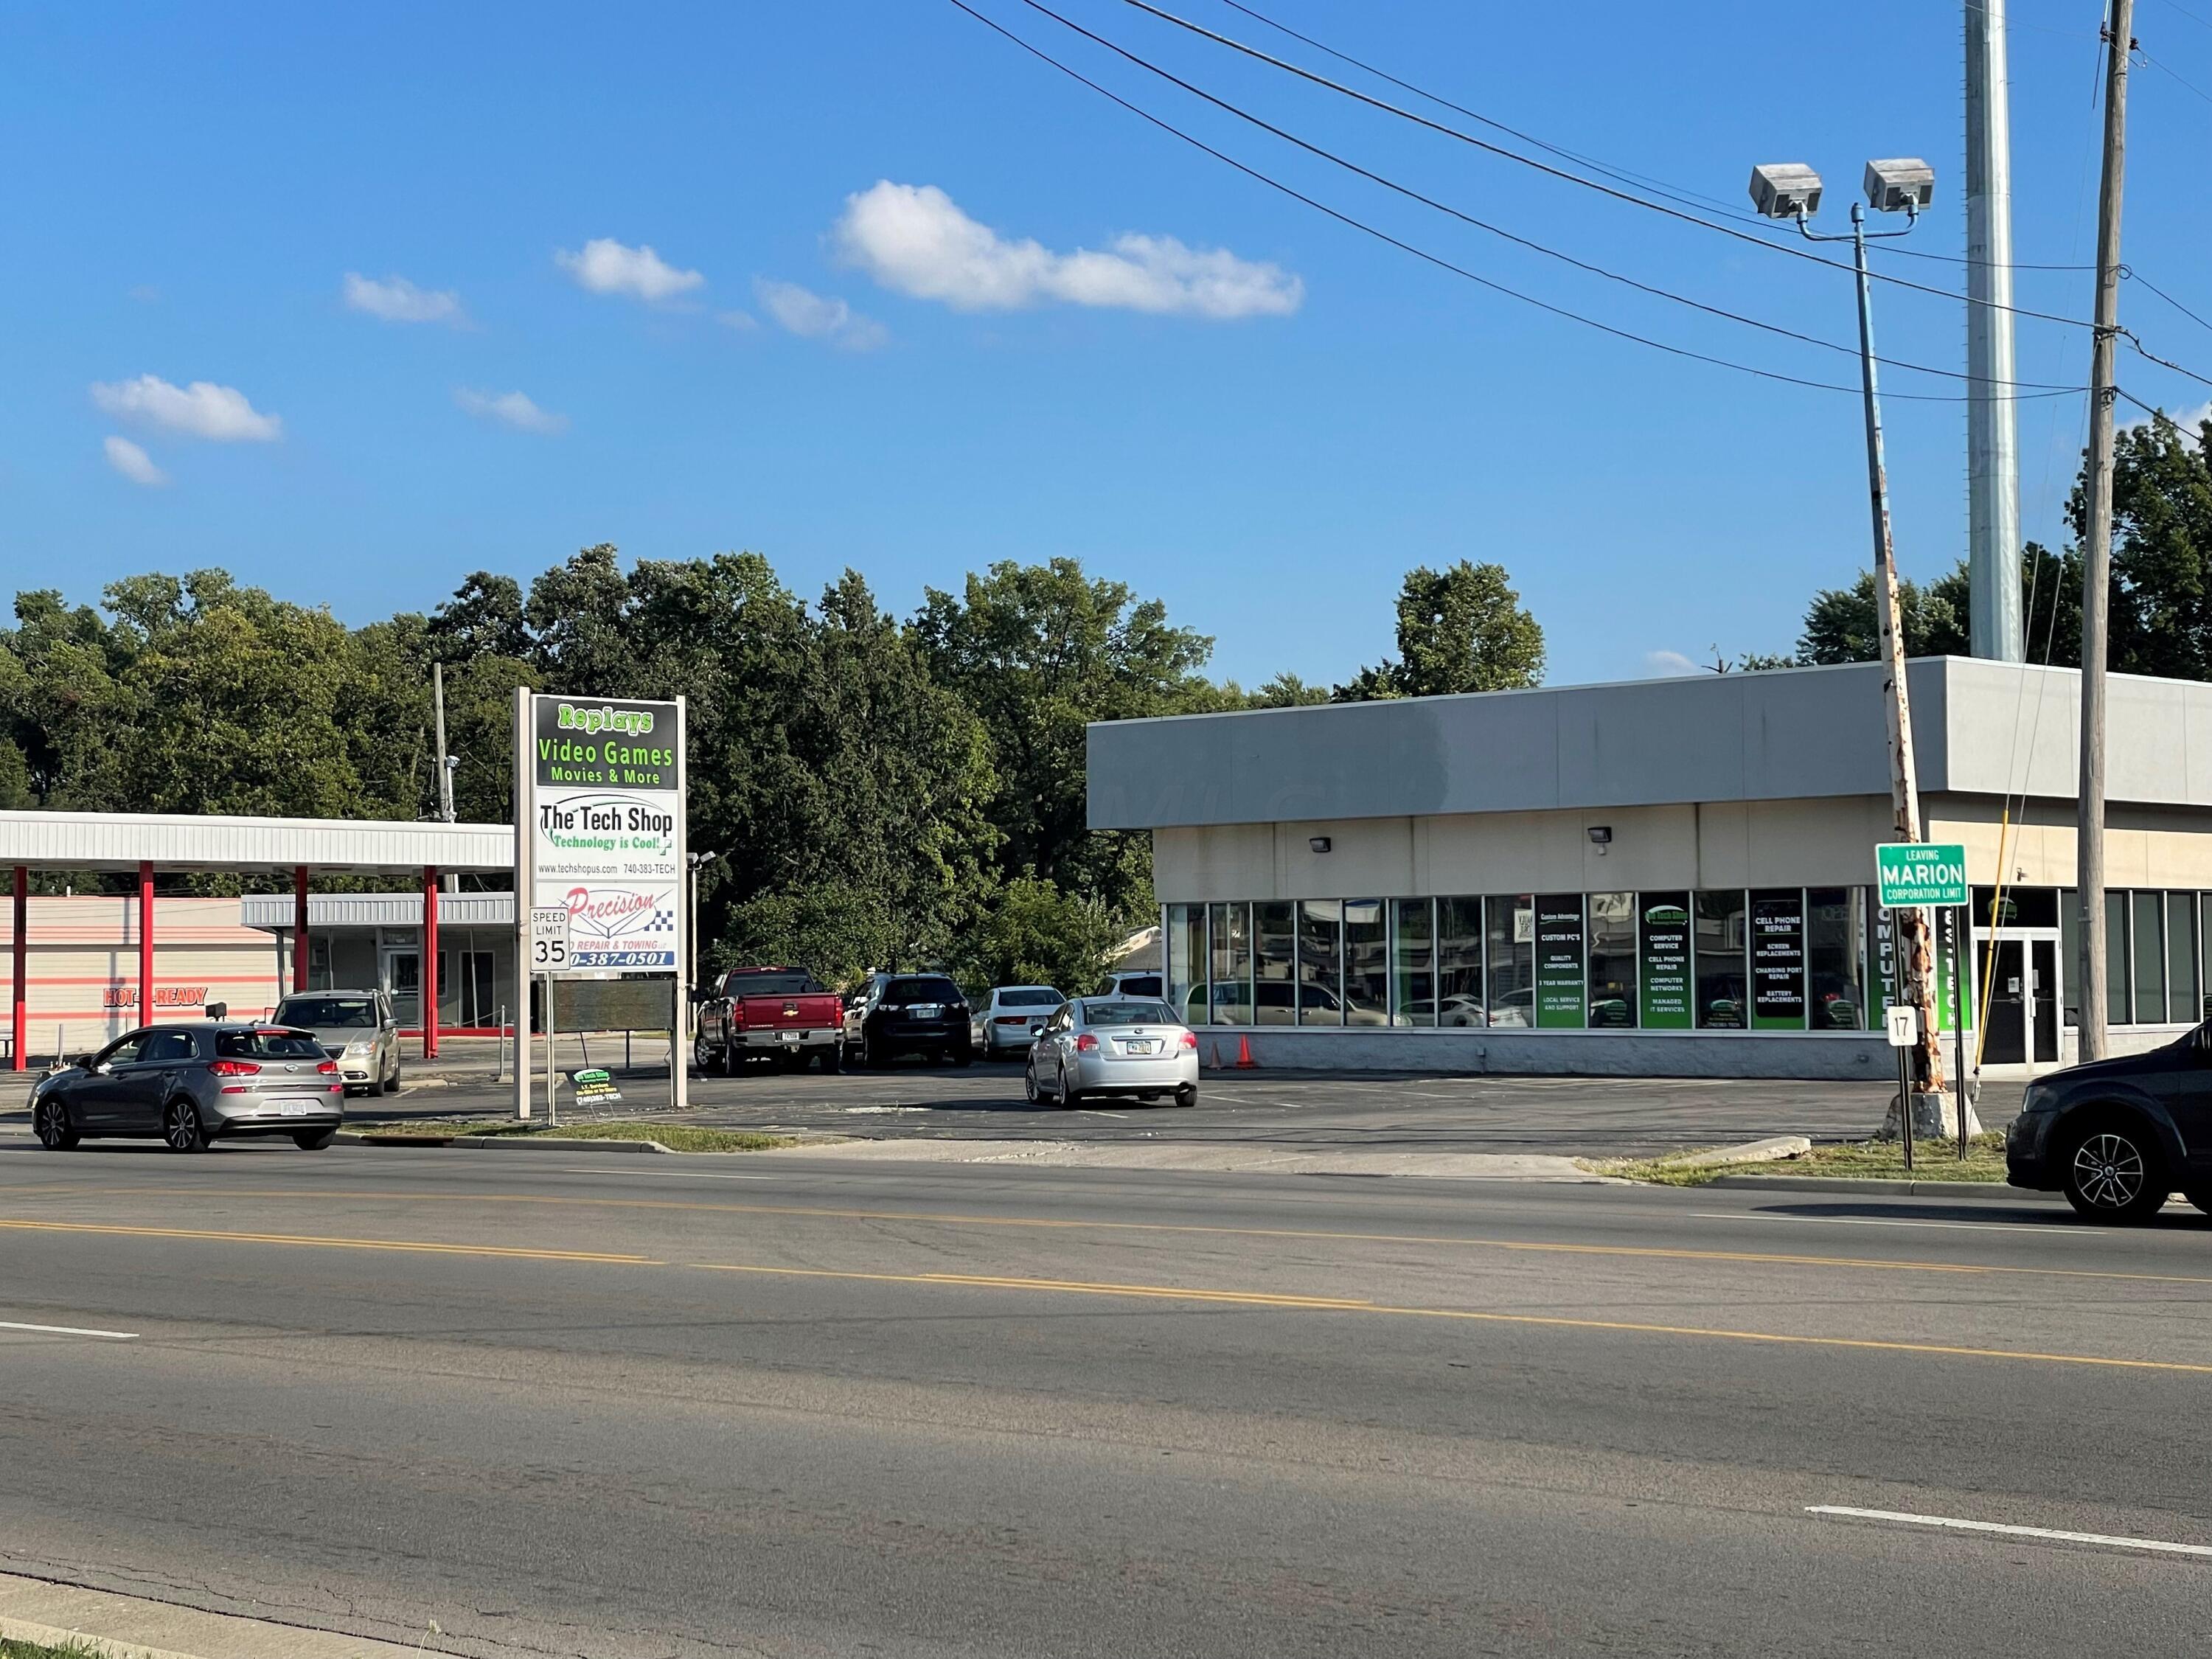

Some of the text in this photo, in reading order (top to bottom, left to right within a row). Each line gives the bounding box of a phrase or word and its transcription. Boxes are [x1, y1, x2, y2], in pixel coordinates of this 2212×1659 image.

[558, 703, 653, 736] Replays
[539, 739, 672, 766] Video Games
[552, 767, 660, 784] Movies & More
[540, 805, 672, 837] The Tech Shop
[554, 835, 660, 851] Technology is Cool!
[1906, 849, 1939, 861] LEAVING
[538, 863, 675, 876] www.techshopus.com 740-383-TECH
[1882, 863, 1963, 886] MARION
[1887, 888, 1961, 900] CORPORATION LIMIT
[566, 887, 655, 922] Precision
[533, 913, 566, 922] SPEED
[537, 926, 562, 935] LIMIT
[535, 941, 565, 963] 35
[577, 941, 610, 950] REPAIR
[613, 941, 619, 950] &
[623, 941, 658, 950] TOWING
[571, 952, 666, 966] 0-387-0501
[1877, 908, 1895, 1028] OMPUTE
[1895, 1017, 1908, 1036] 17
